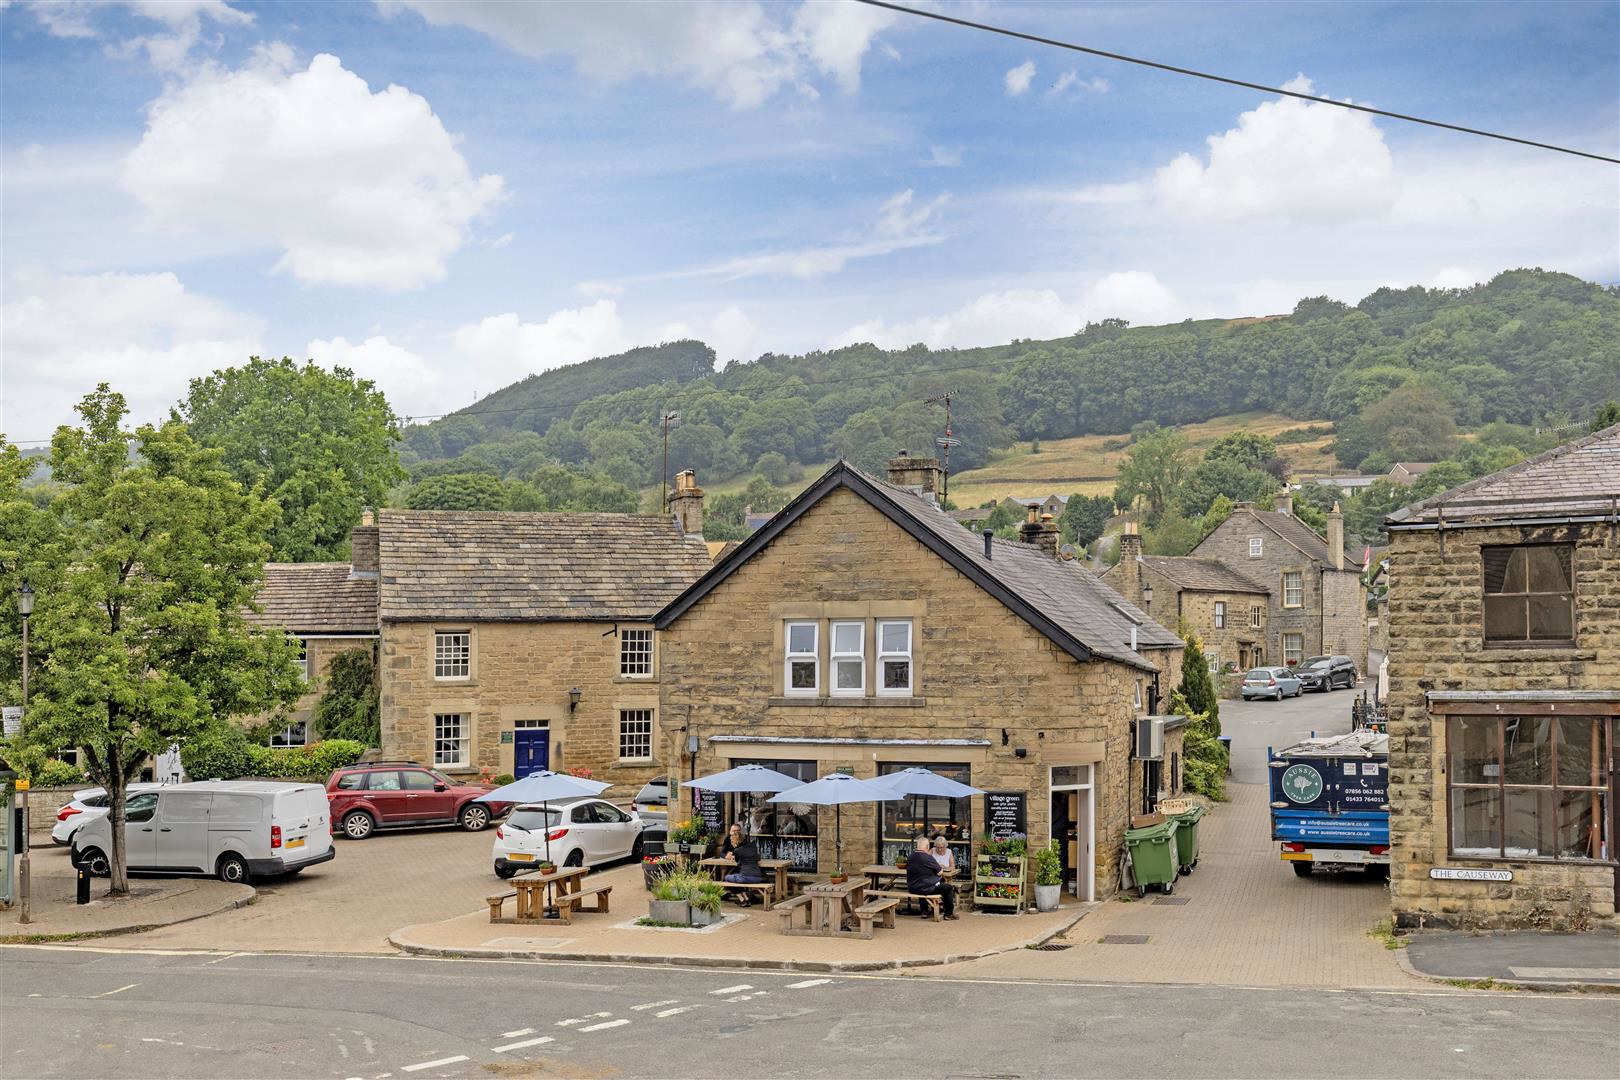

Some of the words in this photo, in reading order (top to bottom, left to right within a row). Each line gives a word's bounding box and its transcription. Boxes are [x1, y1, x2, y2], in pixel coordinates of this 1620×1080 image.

[1288, 768, 1317, 779] AUSSIE
[1433, 870, 1453, 878] THE
[1456, 870, 1510, 880] CAUSEWAY
